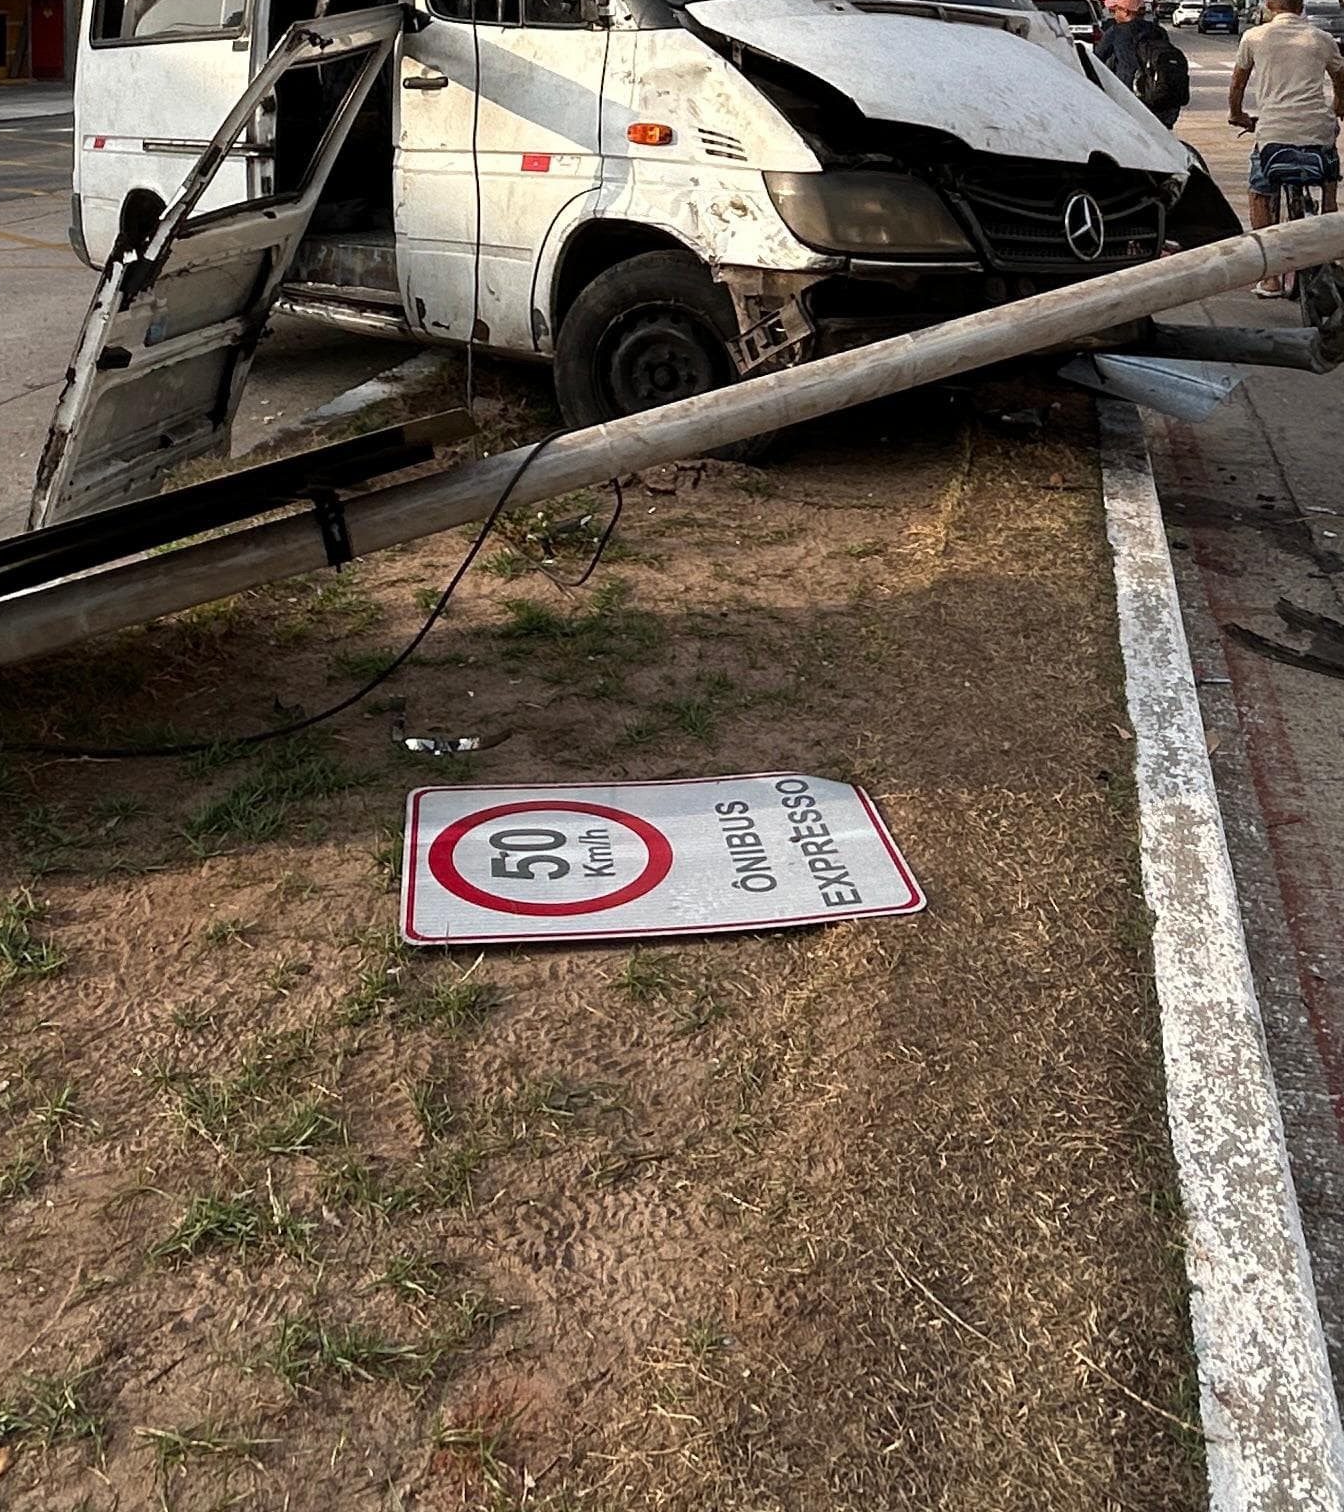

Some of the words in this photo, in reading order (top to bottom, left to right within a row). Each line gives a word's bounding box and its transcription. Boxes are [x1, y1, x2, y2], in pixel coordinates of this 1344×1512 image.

[490, 828, 570, 881] 50
[579, 828, 616, 878] Km/h
[714, 800, 777, 893] ÔNIBUS
[775, 779, 862, 907] EXPRESSO
